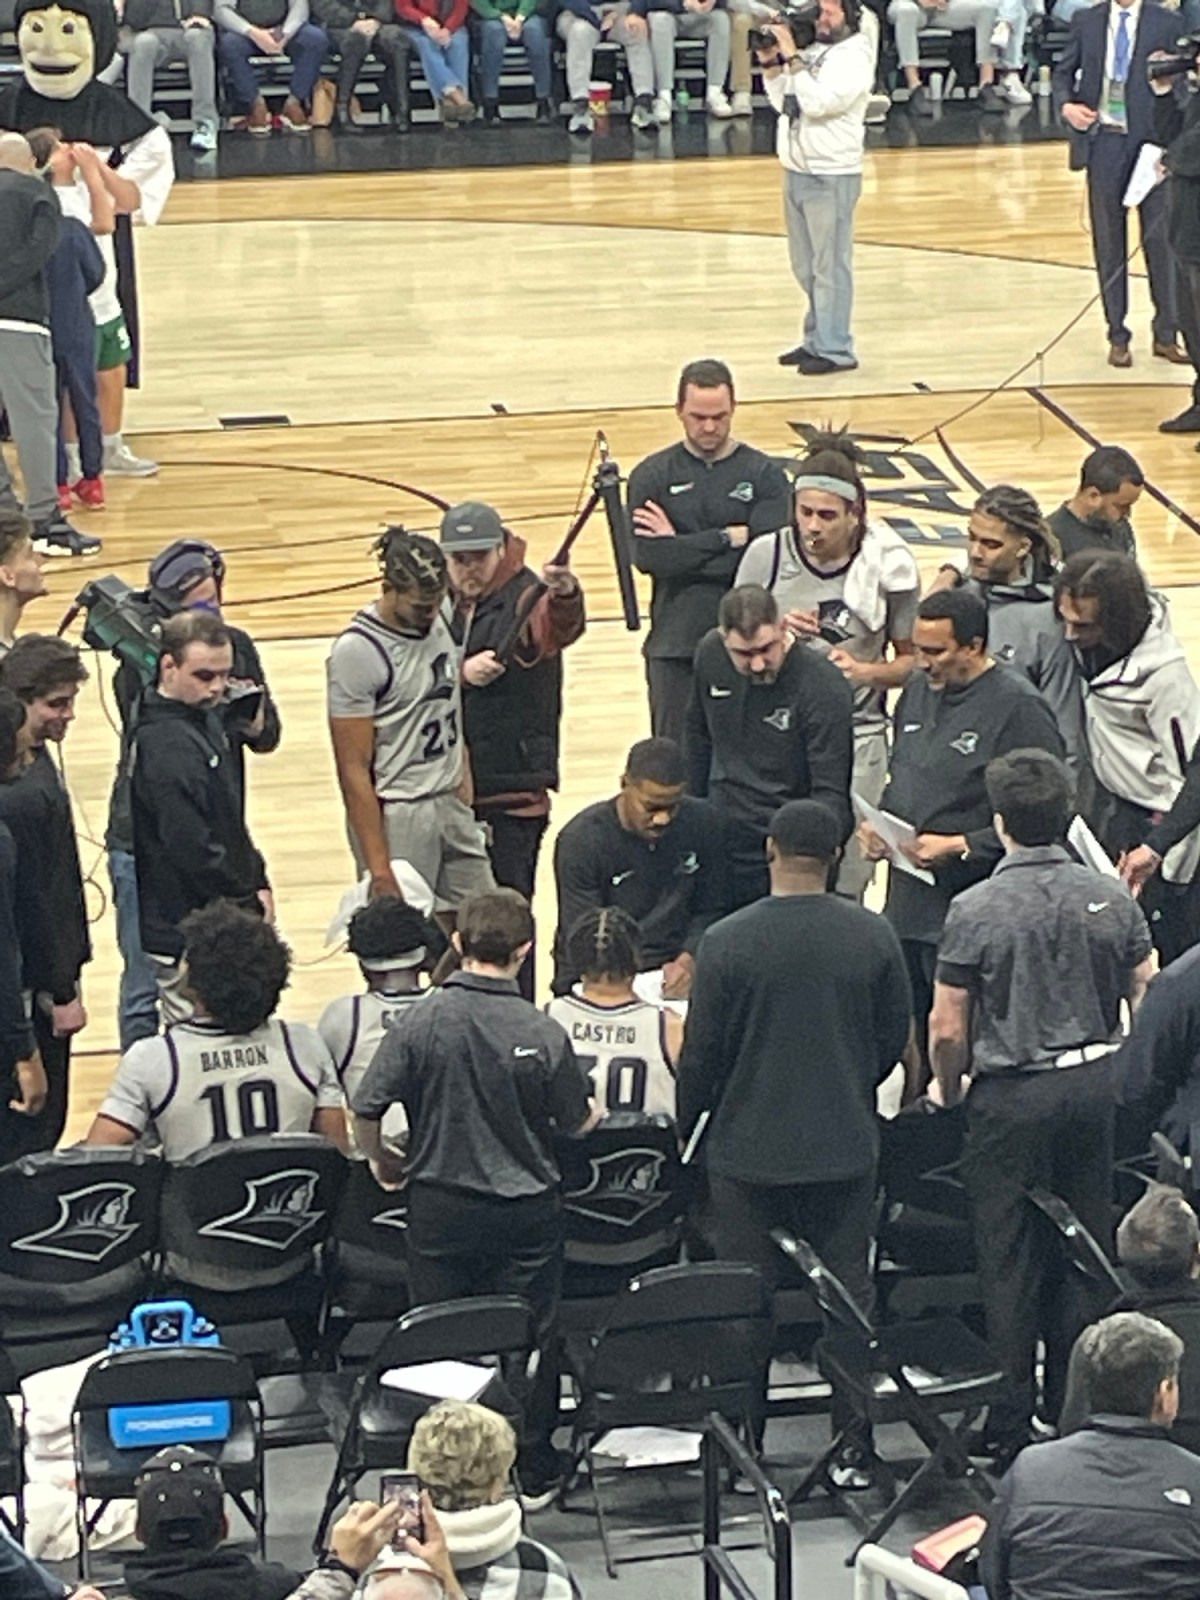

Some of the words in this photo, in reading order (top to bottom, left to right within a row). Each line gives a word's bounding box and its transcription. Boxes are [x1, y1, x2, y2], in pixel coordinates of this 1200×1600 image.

[573, 1022, 636, 1044] CASTRO
[201, 1045, 268, 1072] BARRON
[199, 1080, 279, 1142] 10
